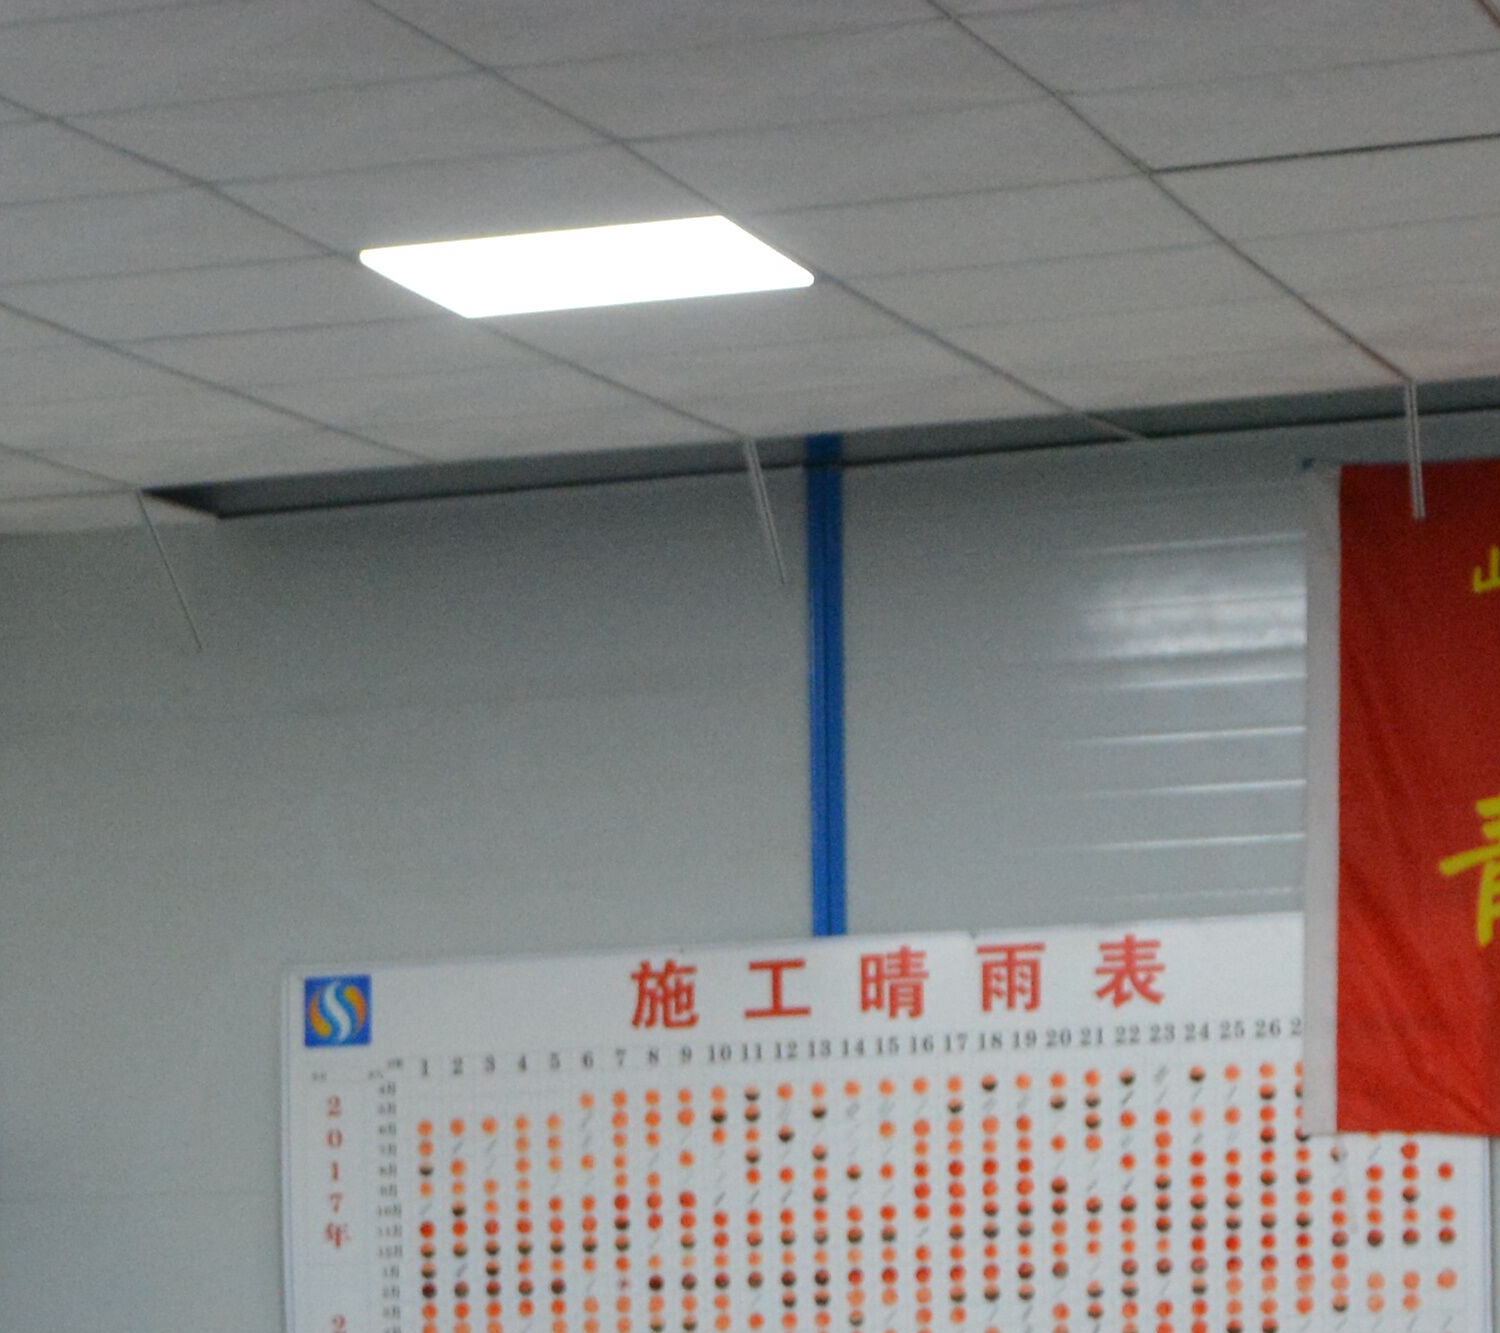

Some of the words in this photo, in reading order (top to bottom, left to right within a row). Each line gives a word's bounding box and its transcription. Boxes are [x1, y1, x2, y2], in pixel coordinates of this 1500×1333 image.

[631, 933, 1166, 1029] 施工晴雨表
[420, 1058, 430, 1078] 1
[451, 1056, 464, 1077] 2
[483, 1054, 497, 1075] 3
[516, 1054, 528, 1073] 4
[548, 1051, 562, 1072] 5
[580, 1050, 595, 1070] 6
[614, 1047, 627, 1068] 7
[646, 1048, 660, 1066] 8
[678, 1045, 694, 1065] 9
[707, 1043, 733, 1065] 10
[740, 1042, 763, 1063] 11
[774, 1040, 799, 1062] 12
[807, 1038, 833, 1060] 13
[841, 1038, 866, 1059] 14
[875, 1035, 901, 1057] 15
[909, 1034, 935, 1055] 16
[943, 1031, 969, 1054] 17
[978, 1032, 1004, 1052] 18
[1012, 1029, 1038, 1051] 19
[1044, 1027, 1073, 1050] 20
[1078, 1026, 1104, 1049] 21
[1113, 1024, 1141, 1047] 22
[1148, 1022, 1177, 1045] 23
[1183, 1021, 1211, 1044] 24
[1218, 1019, 1246, 1042] 25
[1254, 1018, 1282, 1040] 26
